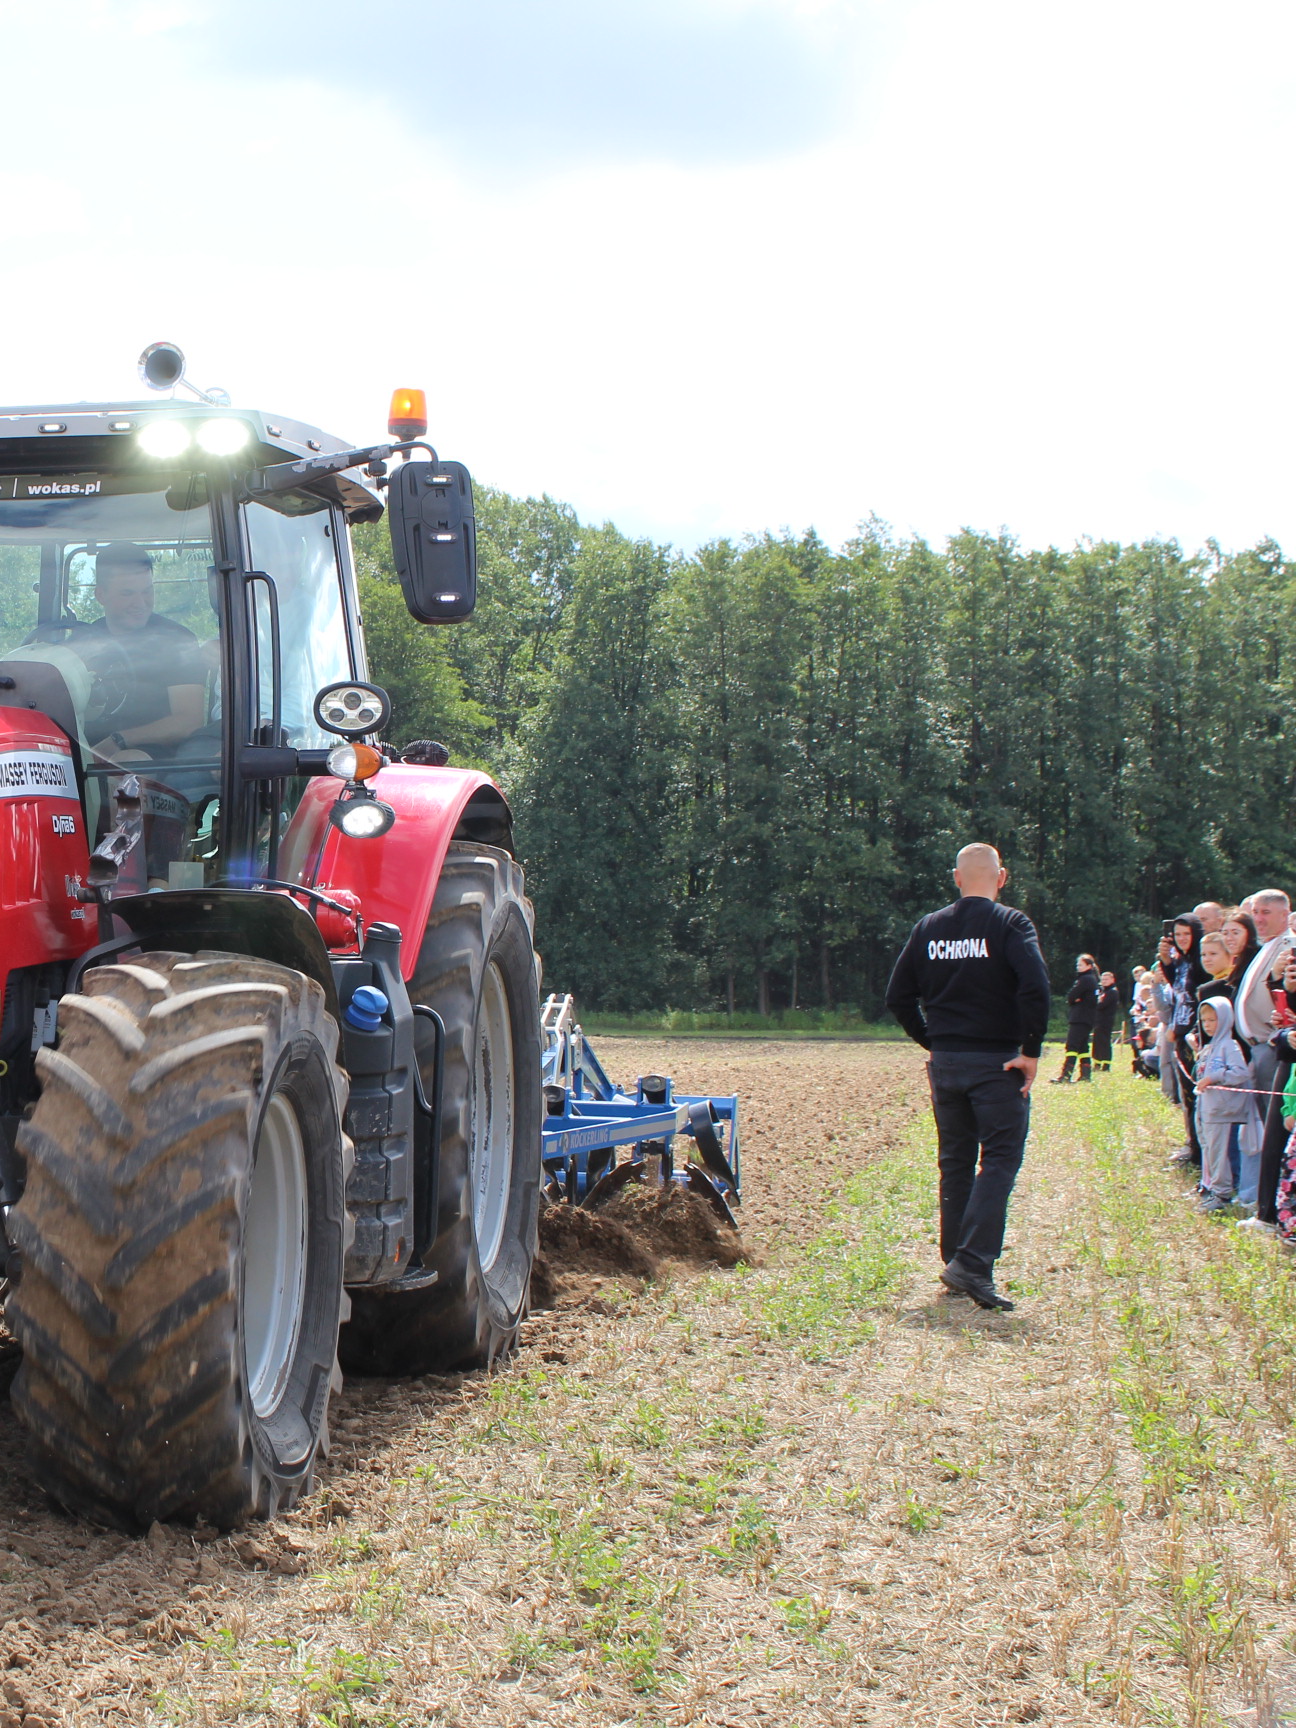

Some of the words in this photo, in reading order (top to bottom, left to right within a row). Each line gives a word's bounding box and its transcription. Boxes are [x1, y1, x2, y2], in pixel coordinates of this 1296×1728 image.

[27, 480, 101, 495] wokas.pl
[29, 761, 68, 788] FERGUSON
[927, 938, 989, 960] OCHRONA
[570, 1128, 609, 1149] KÖCKERLING
